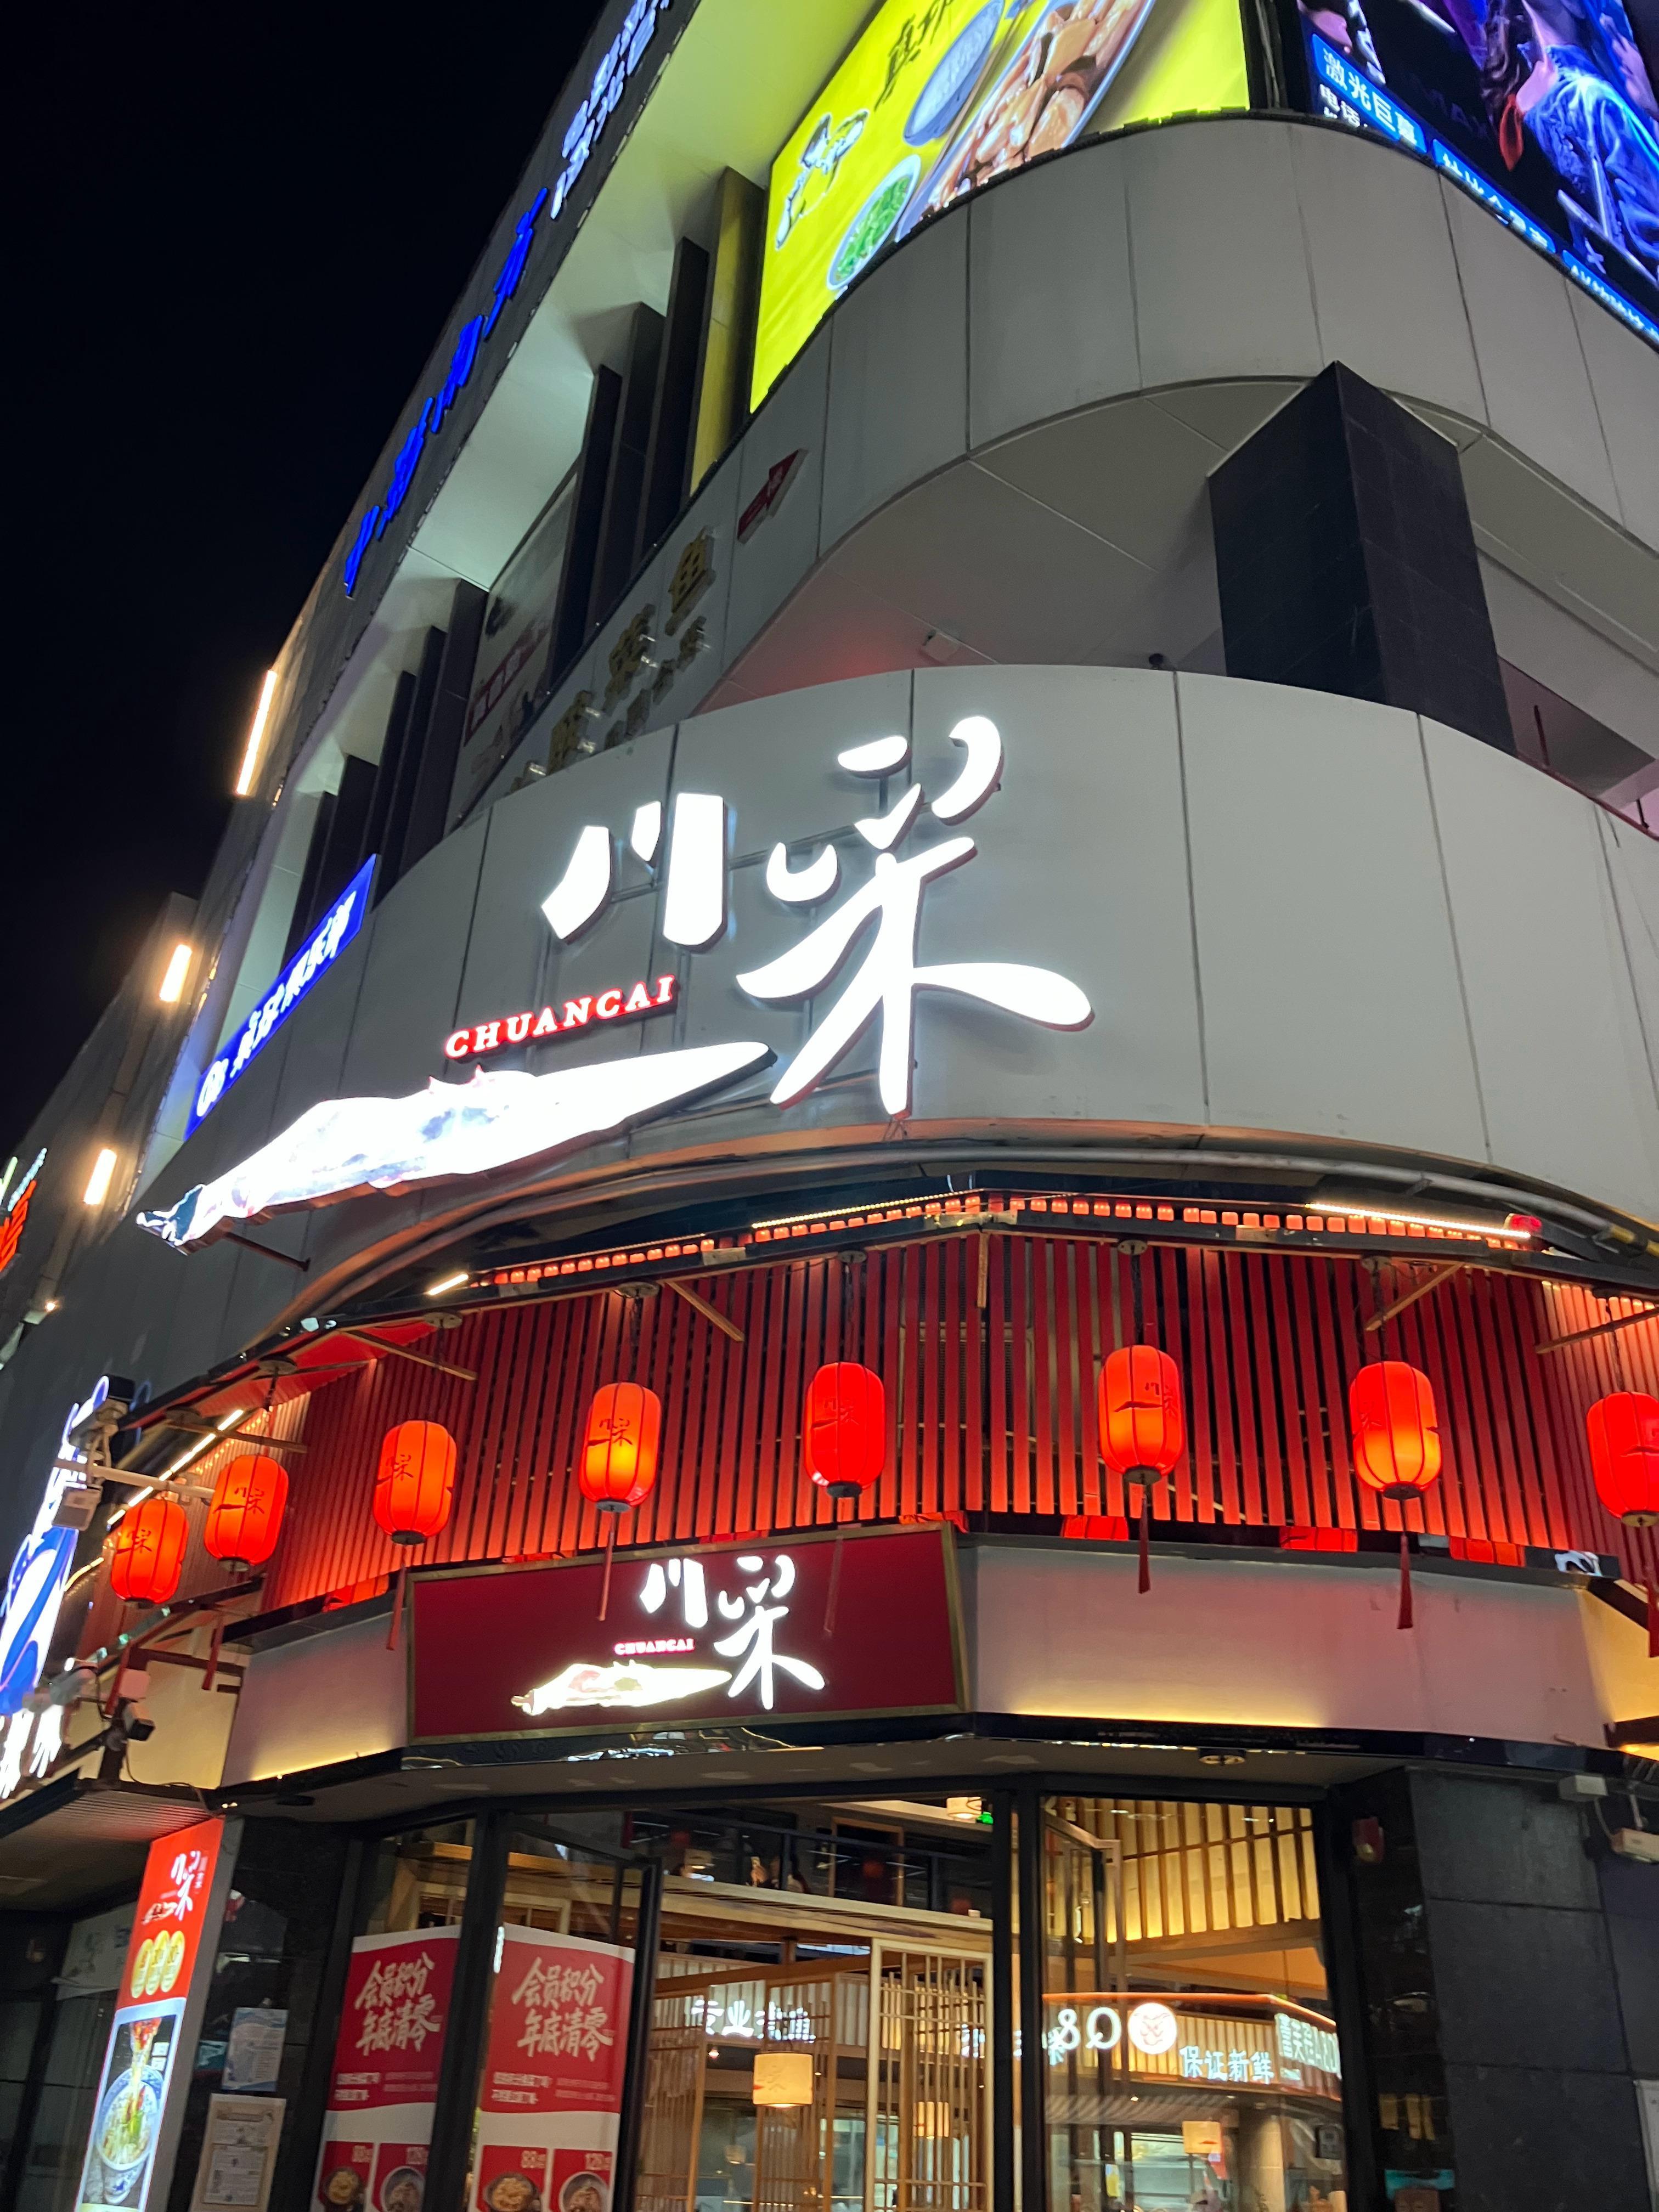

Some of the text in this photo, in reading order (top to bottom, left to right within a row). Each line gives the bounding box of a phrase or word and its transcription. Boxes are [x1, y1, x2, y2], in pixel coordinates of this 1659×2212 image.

[444, 974, 675, 1059] CHUANCAI
[613, 1638, 695, 1656] CHUANCAI
[517, 2006, 614, 2063] 年底清零
[1179, 2045, 1275, 2085] 保证新鲜
